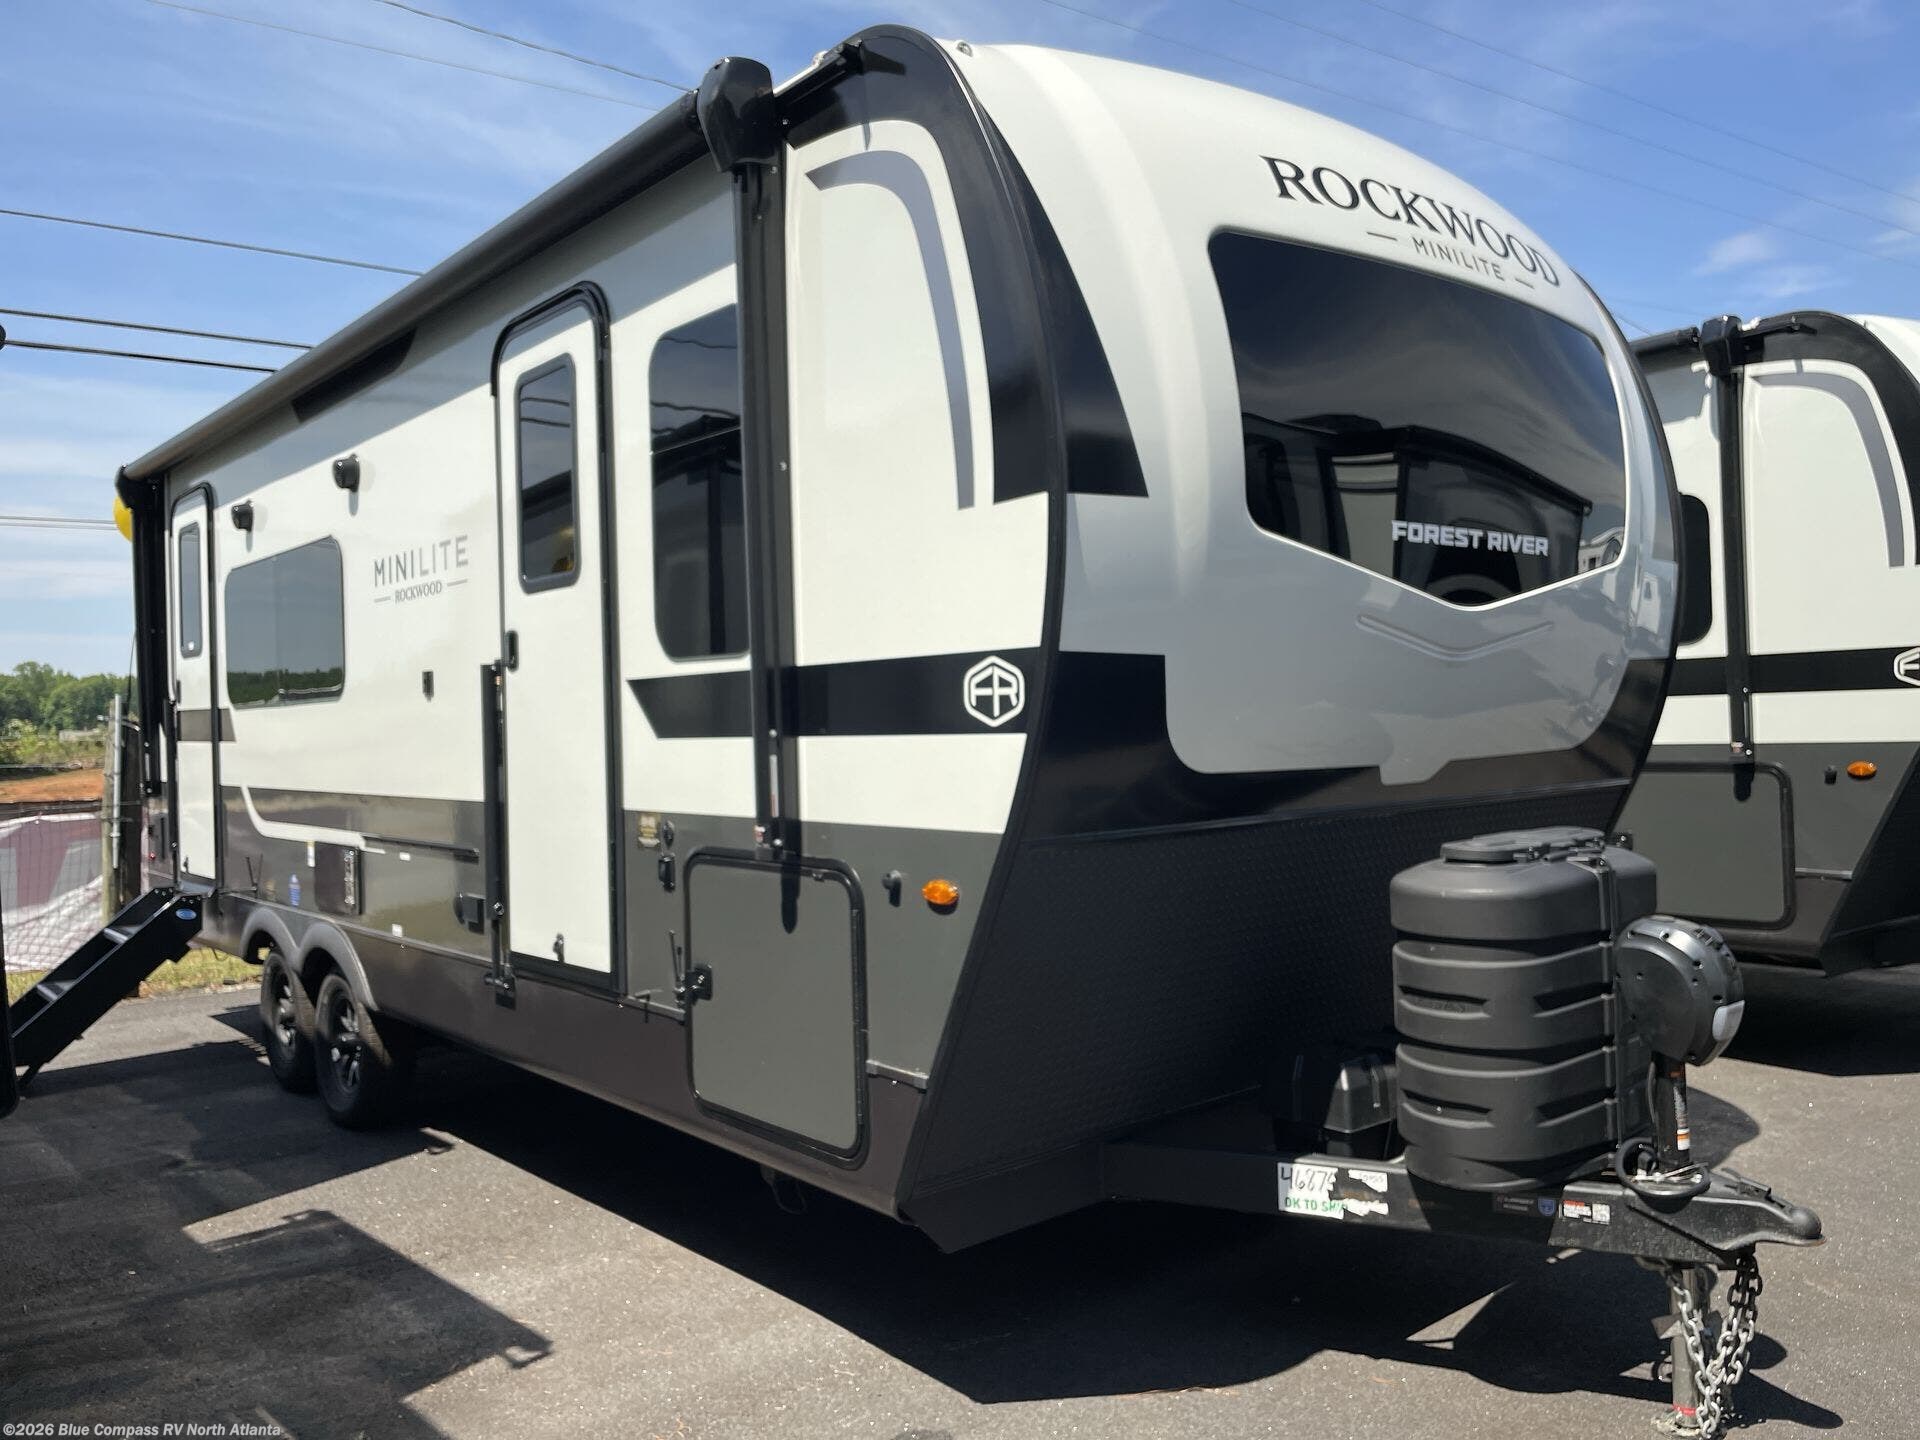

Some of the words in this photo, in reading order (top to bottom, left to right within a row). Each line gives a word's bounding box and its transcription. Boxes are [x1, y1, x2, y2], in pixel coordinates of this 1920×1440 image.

[1258, 154, 1560, 287] ROCKWOOD
[1410, 235, 1506, 282] MINILITE
[373, 534, 469, 588] MINILITE
[1391, 519, 1484, 550] FOREST
[1486, 530, 1549, 557] RIVER
[394, 580, 443, 605] ROCKWOOD
